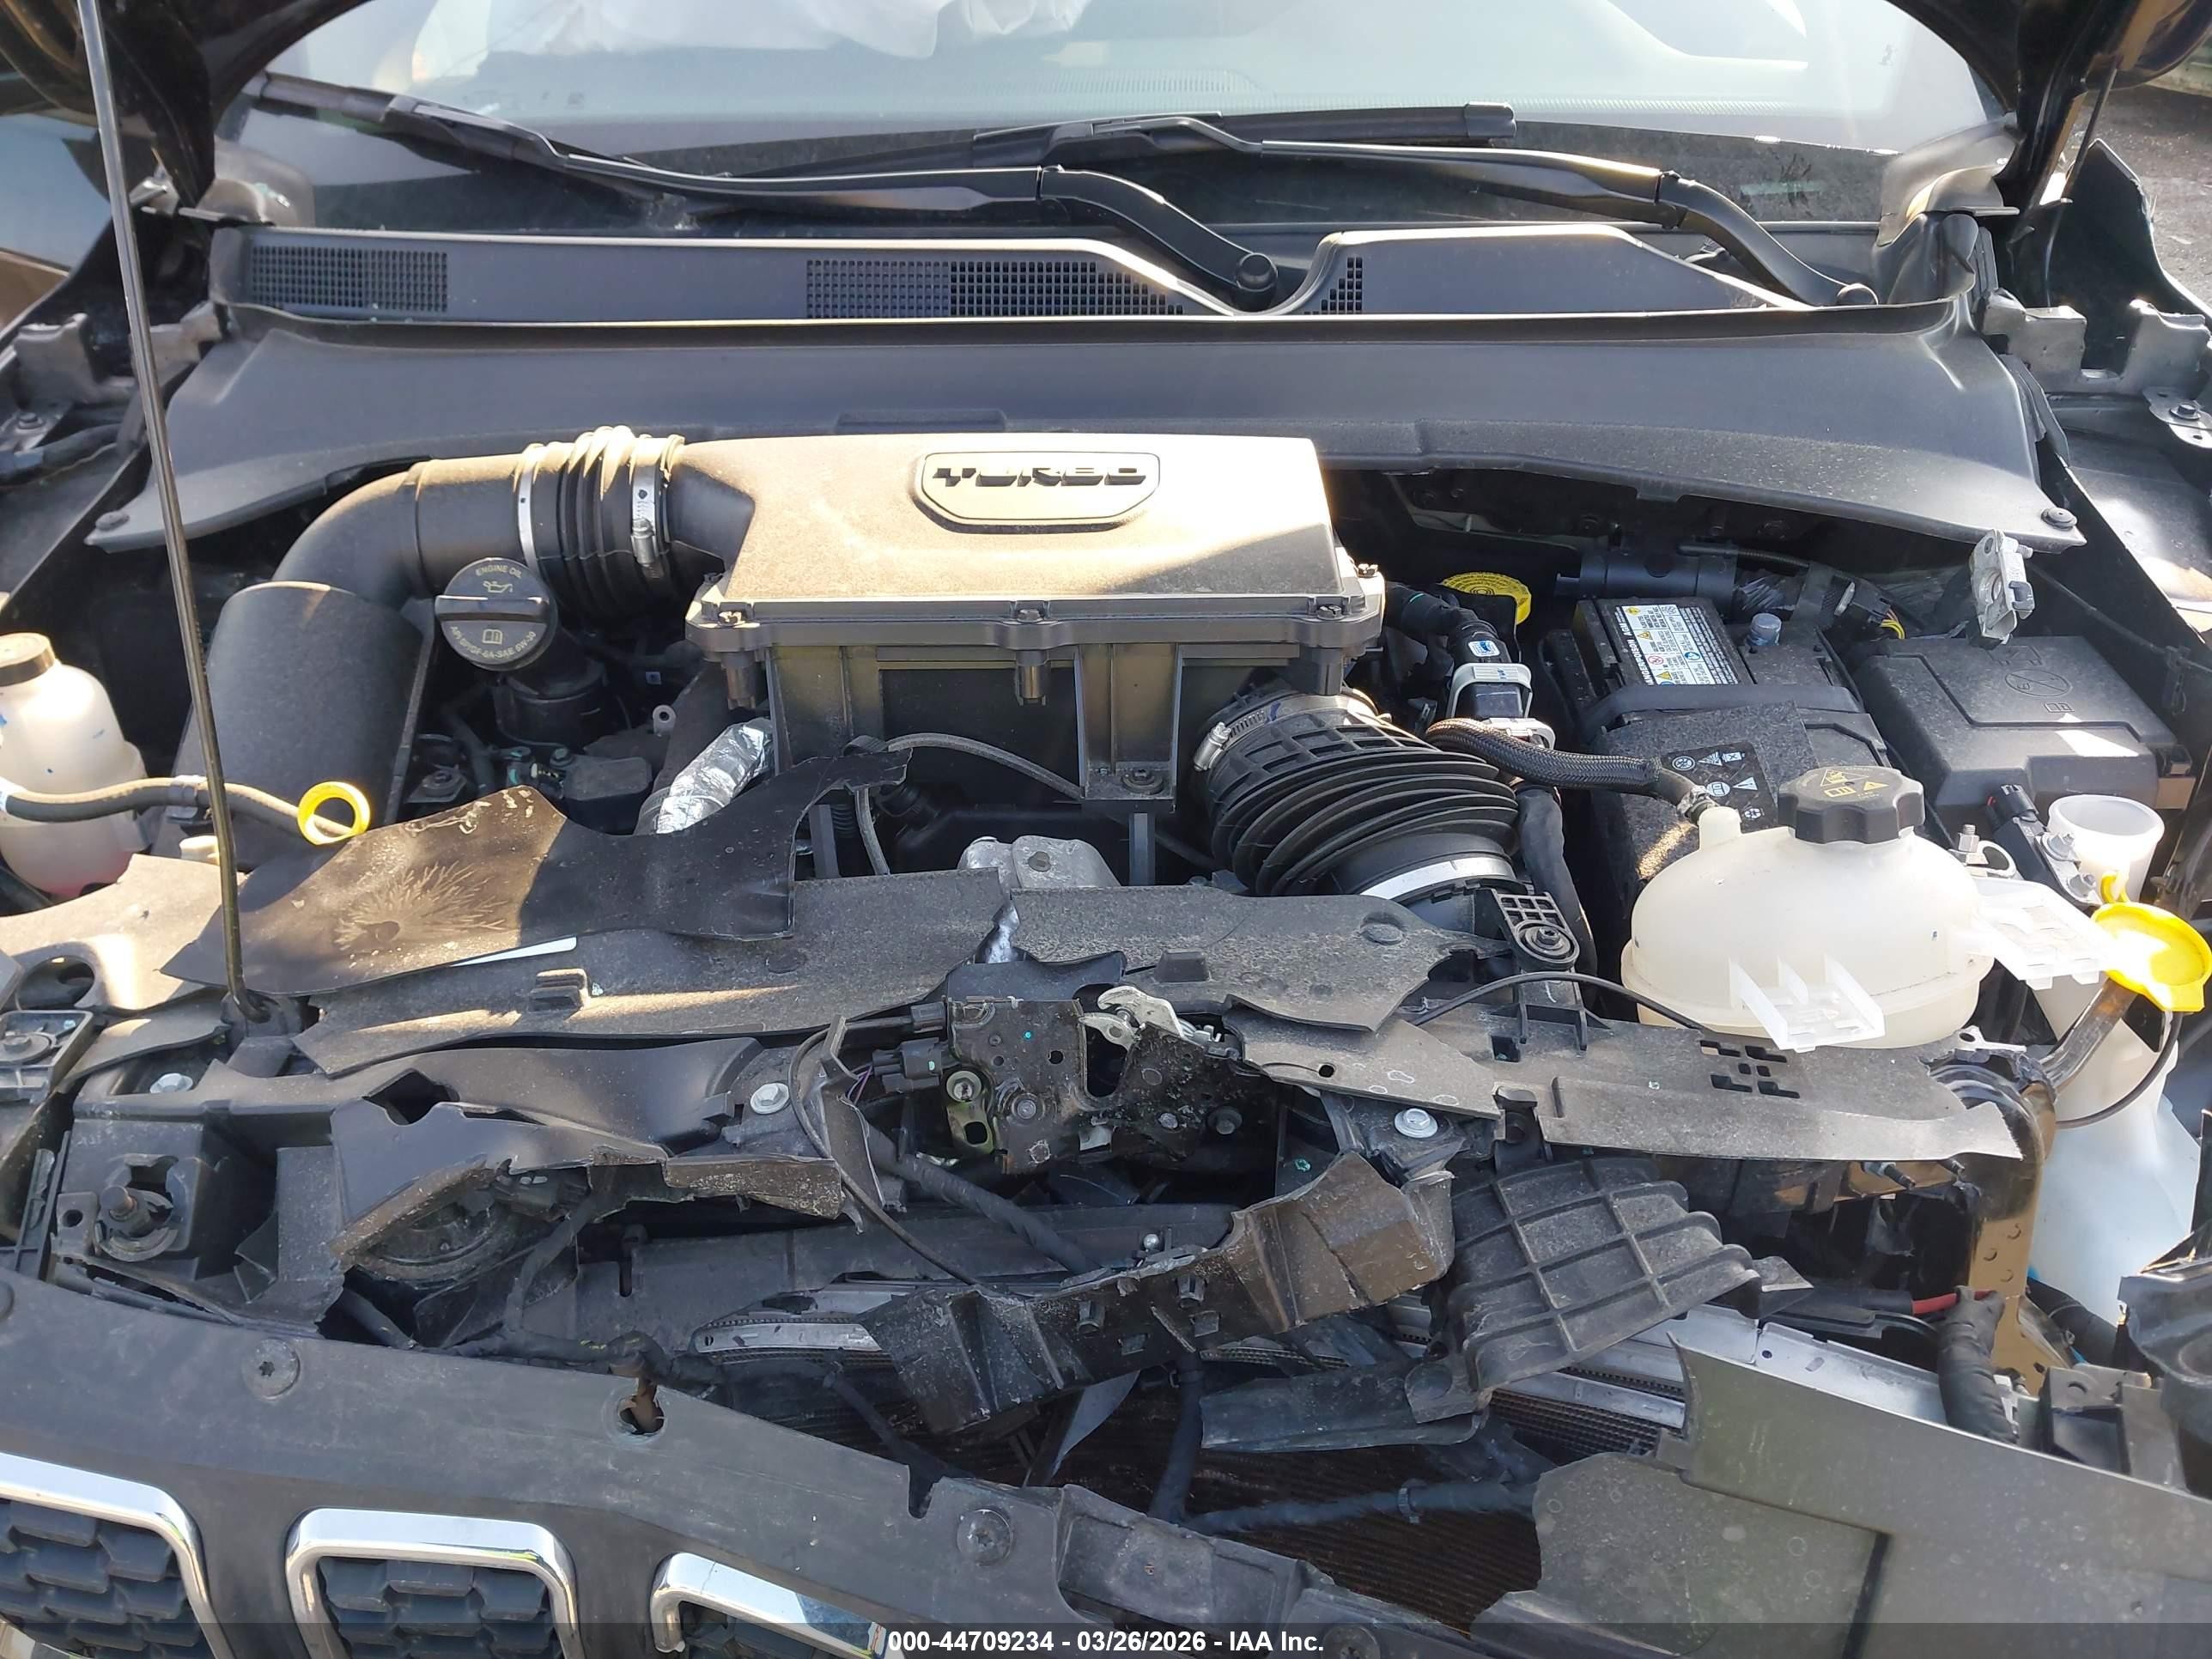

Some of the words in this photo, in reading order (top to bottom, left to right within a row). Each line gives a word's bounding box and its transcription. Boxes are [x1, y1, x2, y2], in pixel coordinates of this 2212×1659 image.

[932, 466, 1148, 488] TURBO
[475, 564, 508, 577] ENGINE
[508, 567, 523, 579] OIL
[1618, 623, 1633, 636] AGM
